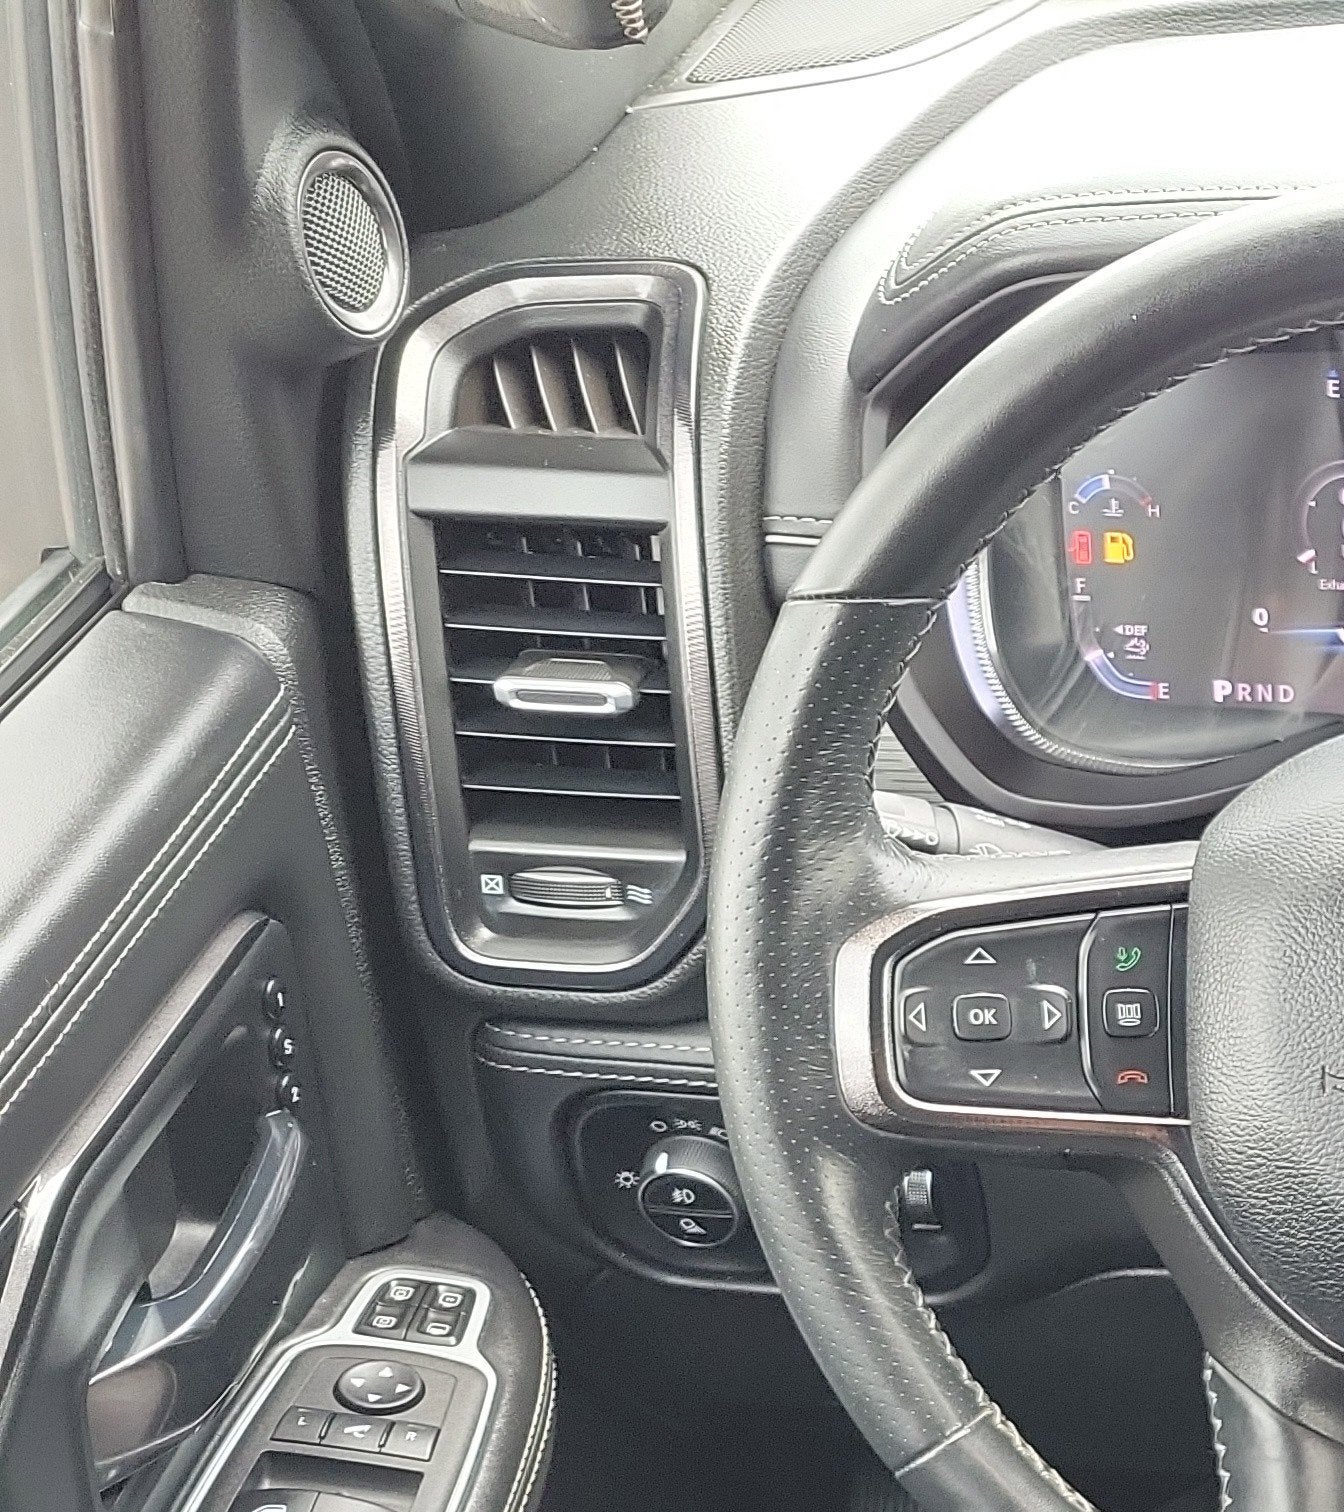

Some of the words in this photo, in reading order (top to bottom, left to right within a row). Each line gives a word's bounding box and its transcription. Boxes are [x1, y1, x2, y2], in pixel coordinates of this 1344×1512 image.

[1326, 379, 1340, 398] E
[1252, 607, 1269, 627] 0
[1124, 625, 1148, 636] DEF
[969, 1008, 998, 1026] OK
